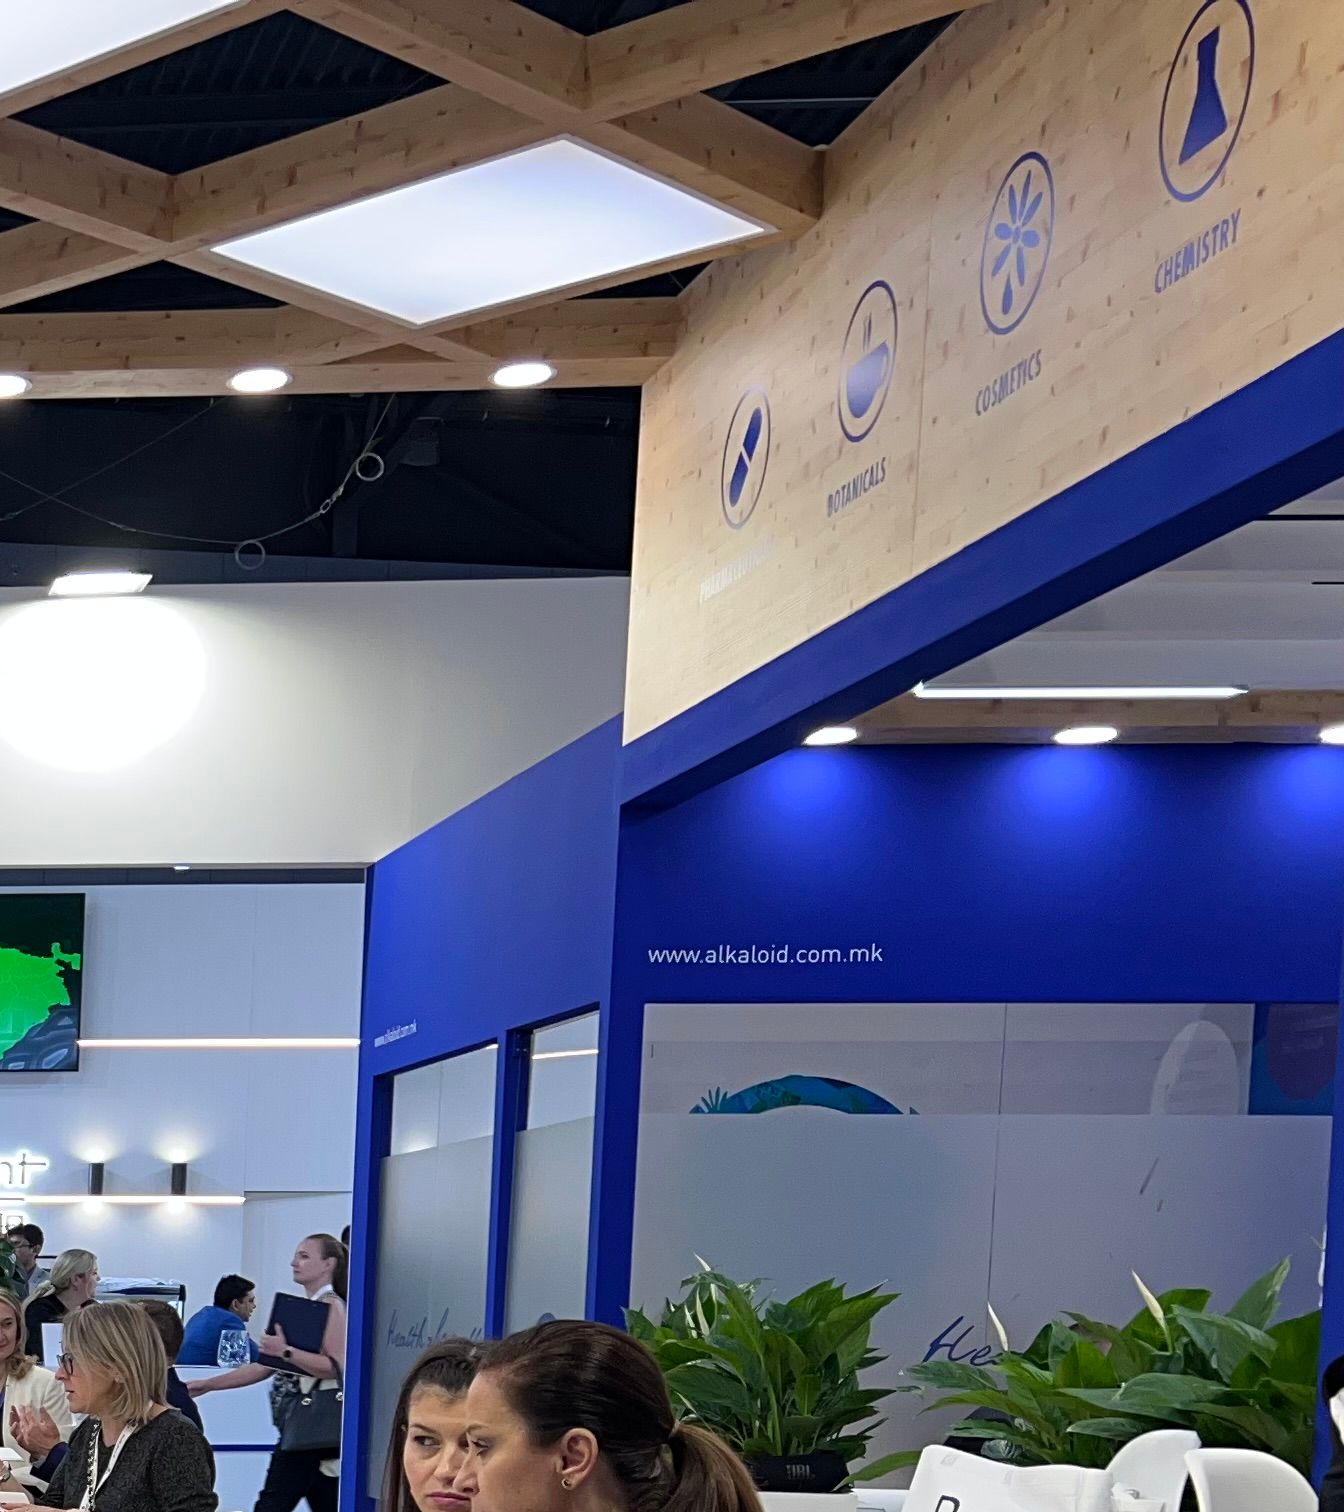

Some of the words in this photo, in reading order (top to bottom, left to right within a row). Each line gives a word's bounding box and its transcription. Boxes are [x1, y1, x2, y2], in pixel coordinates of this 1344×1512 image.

[1154, 207, 1242, 294] CHEMISTRY
[974, 348, 1042, 417] COSMETICS
[827, 456, 887, 518] BOTANICALS
[647, 943, 884, 964] www.alkaloid.com.mk
